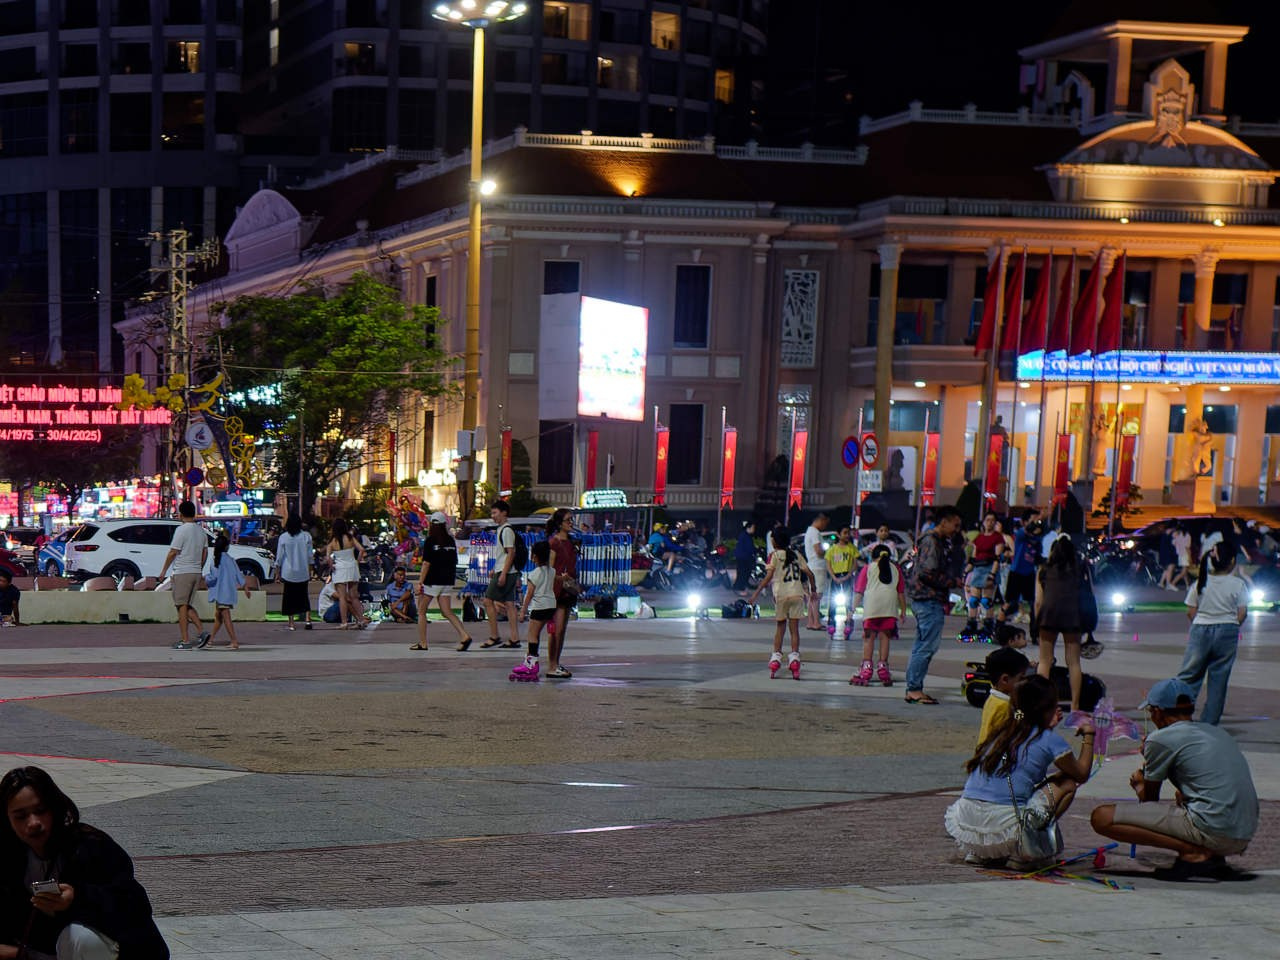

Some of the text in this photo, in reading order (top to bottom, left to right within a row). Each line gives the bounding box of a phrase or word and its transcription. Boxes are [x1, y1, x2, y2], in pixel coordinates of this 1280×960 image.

[17, 384, 45, 402] CHÀO
[48, 384, 79, 402] MỪNG
[82, 388, 96, 402] 50
[99, 385, 122, 403] NĂM
[0, 403, 24, 424] MIỀN
[27, 409, 53, 425] NAM,
[55, 404, 89, 424] THỐNG
[92, 404, 118, 424] NHẤT
[120, 404, 140, 424] ĐẤT
[143, 406, 172, 424] NƯỚC
[47, 429, 101, 442] 30/4/2025)
